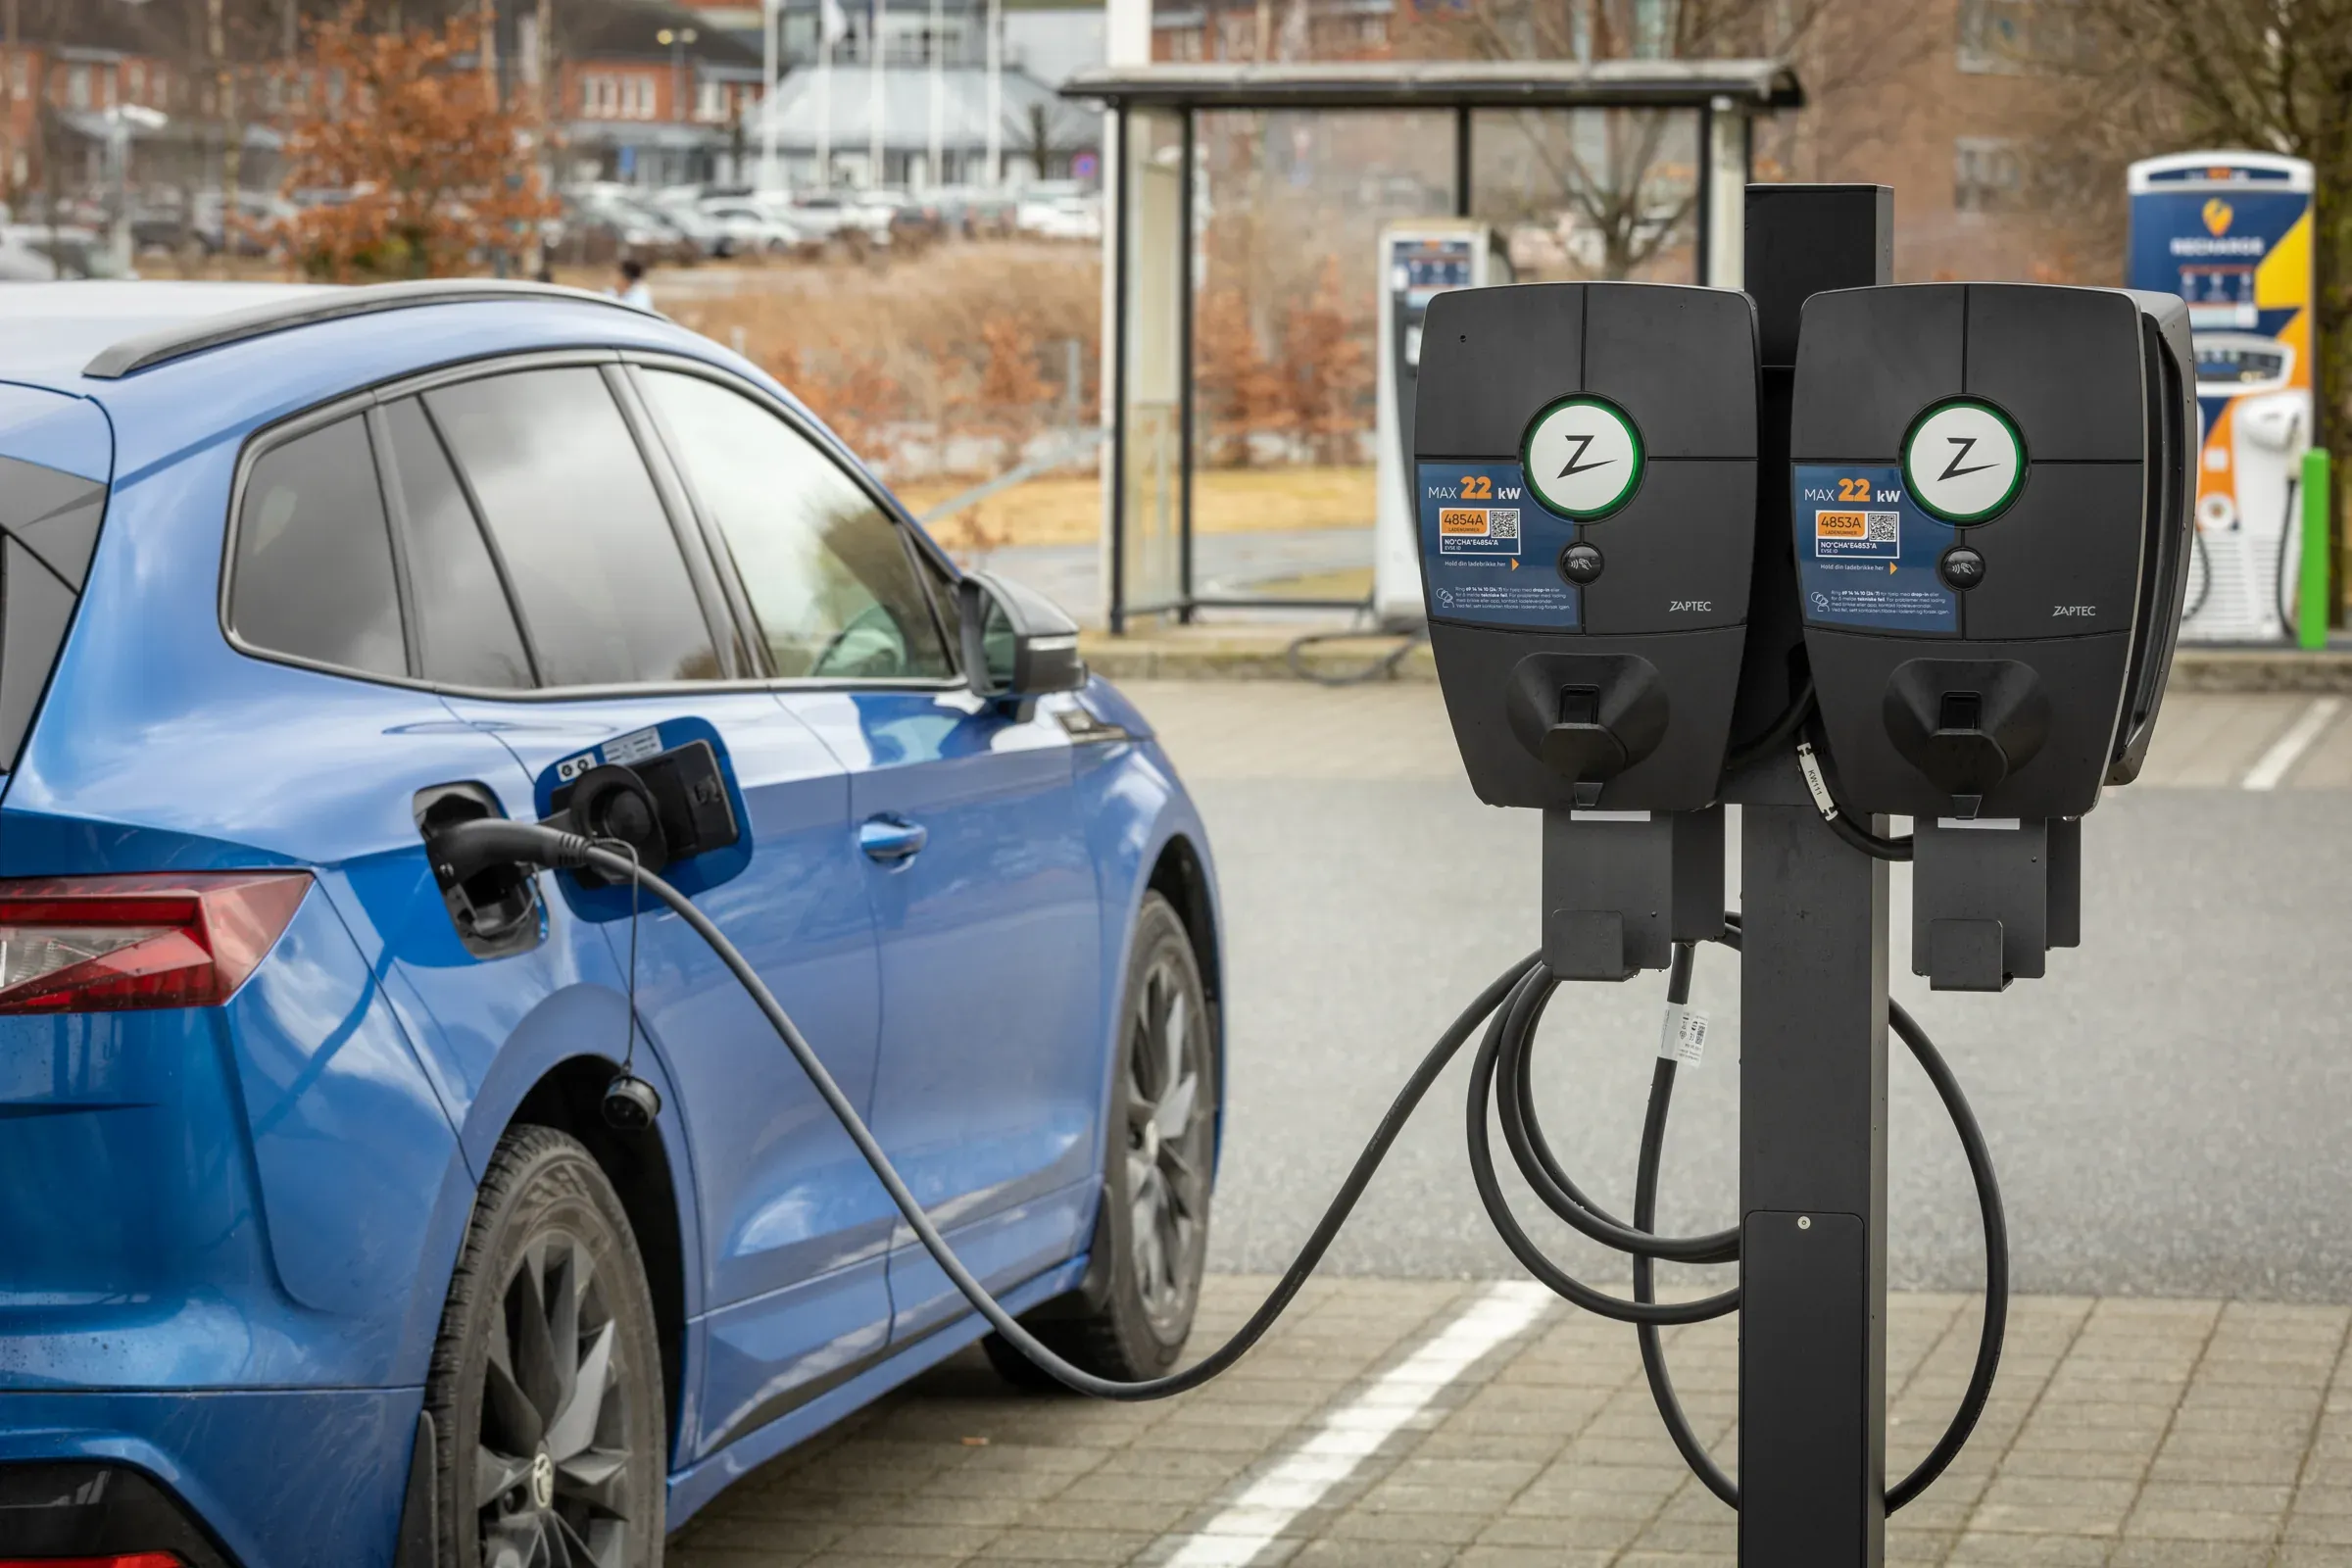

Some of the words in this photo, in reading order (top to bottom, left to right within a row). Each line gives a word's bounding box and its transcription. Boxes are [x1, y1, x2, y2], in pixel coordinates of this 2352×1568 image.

[1428, 486, 1457, 499] MAX
[1460, 475, 1493, 500] 22
[1497, 487, 1521, 500] kW
[1804, 488, 1835, 502] MAX
[1838, 477, 1871, 502] 22
[1877, 490, 1901, 503] kW
[1444, 514, 1484, 525] 4854A
[1821, 516, 1861, 528] 4853A
[1669, 601, 1712, 612] ZAPTEC
[2052, 606, 2096, 616] ZAPTEC
[1807, 769, 1823, 796] KW111
